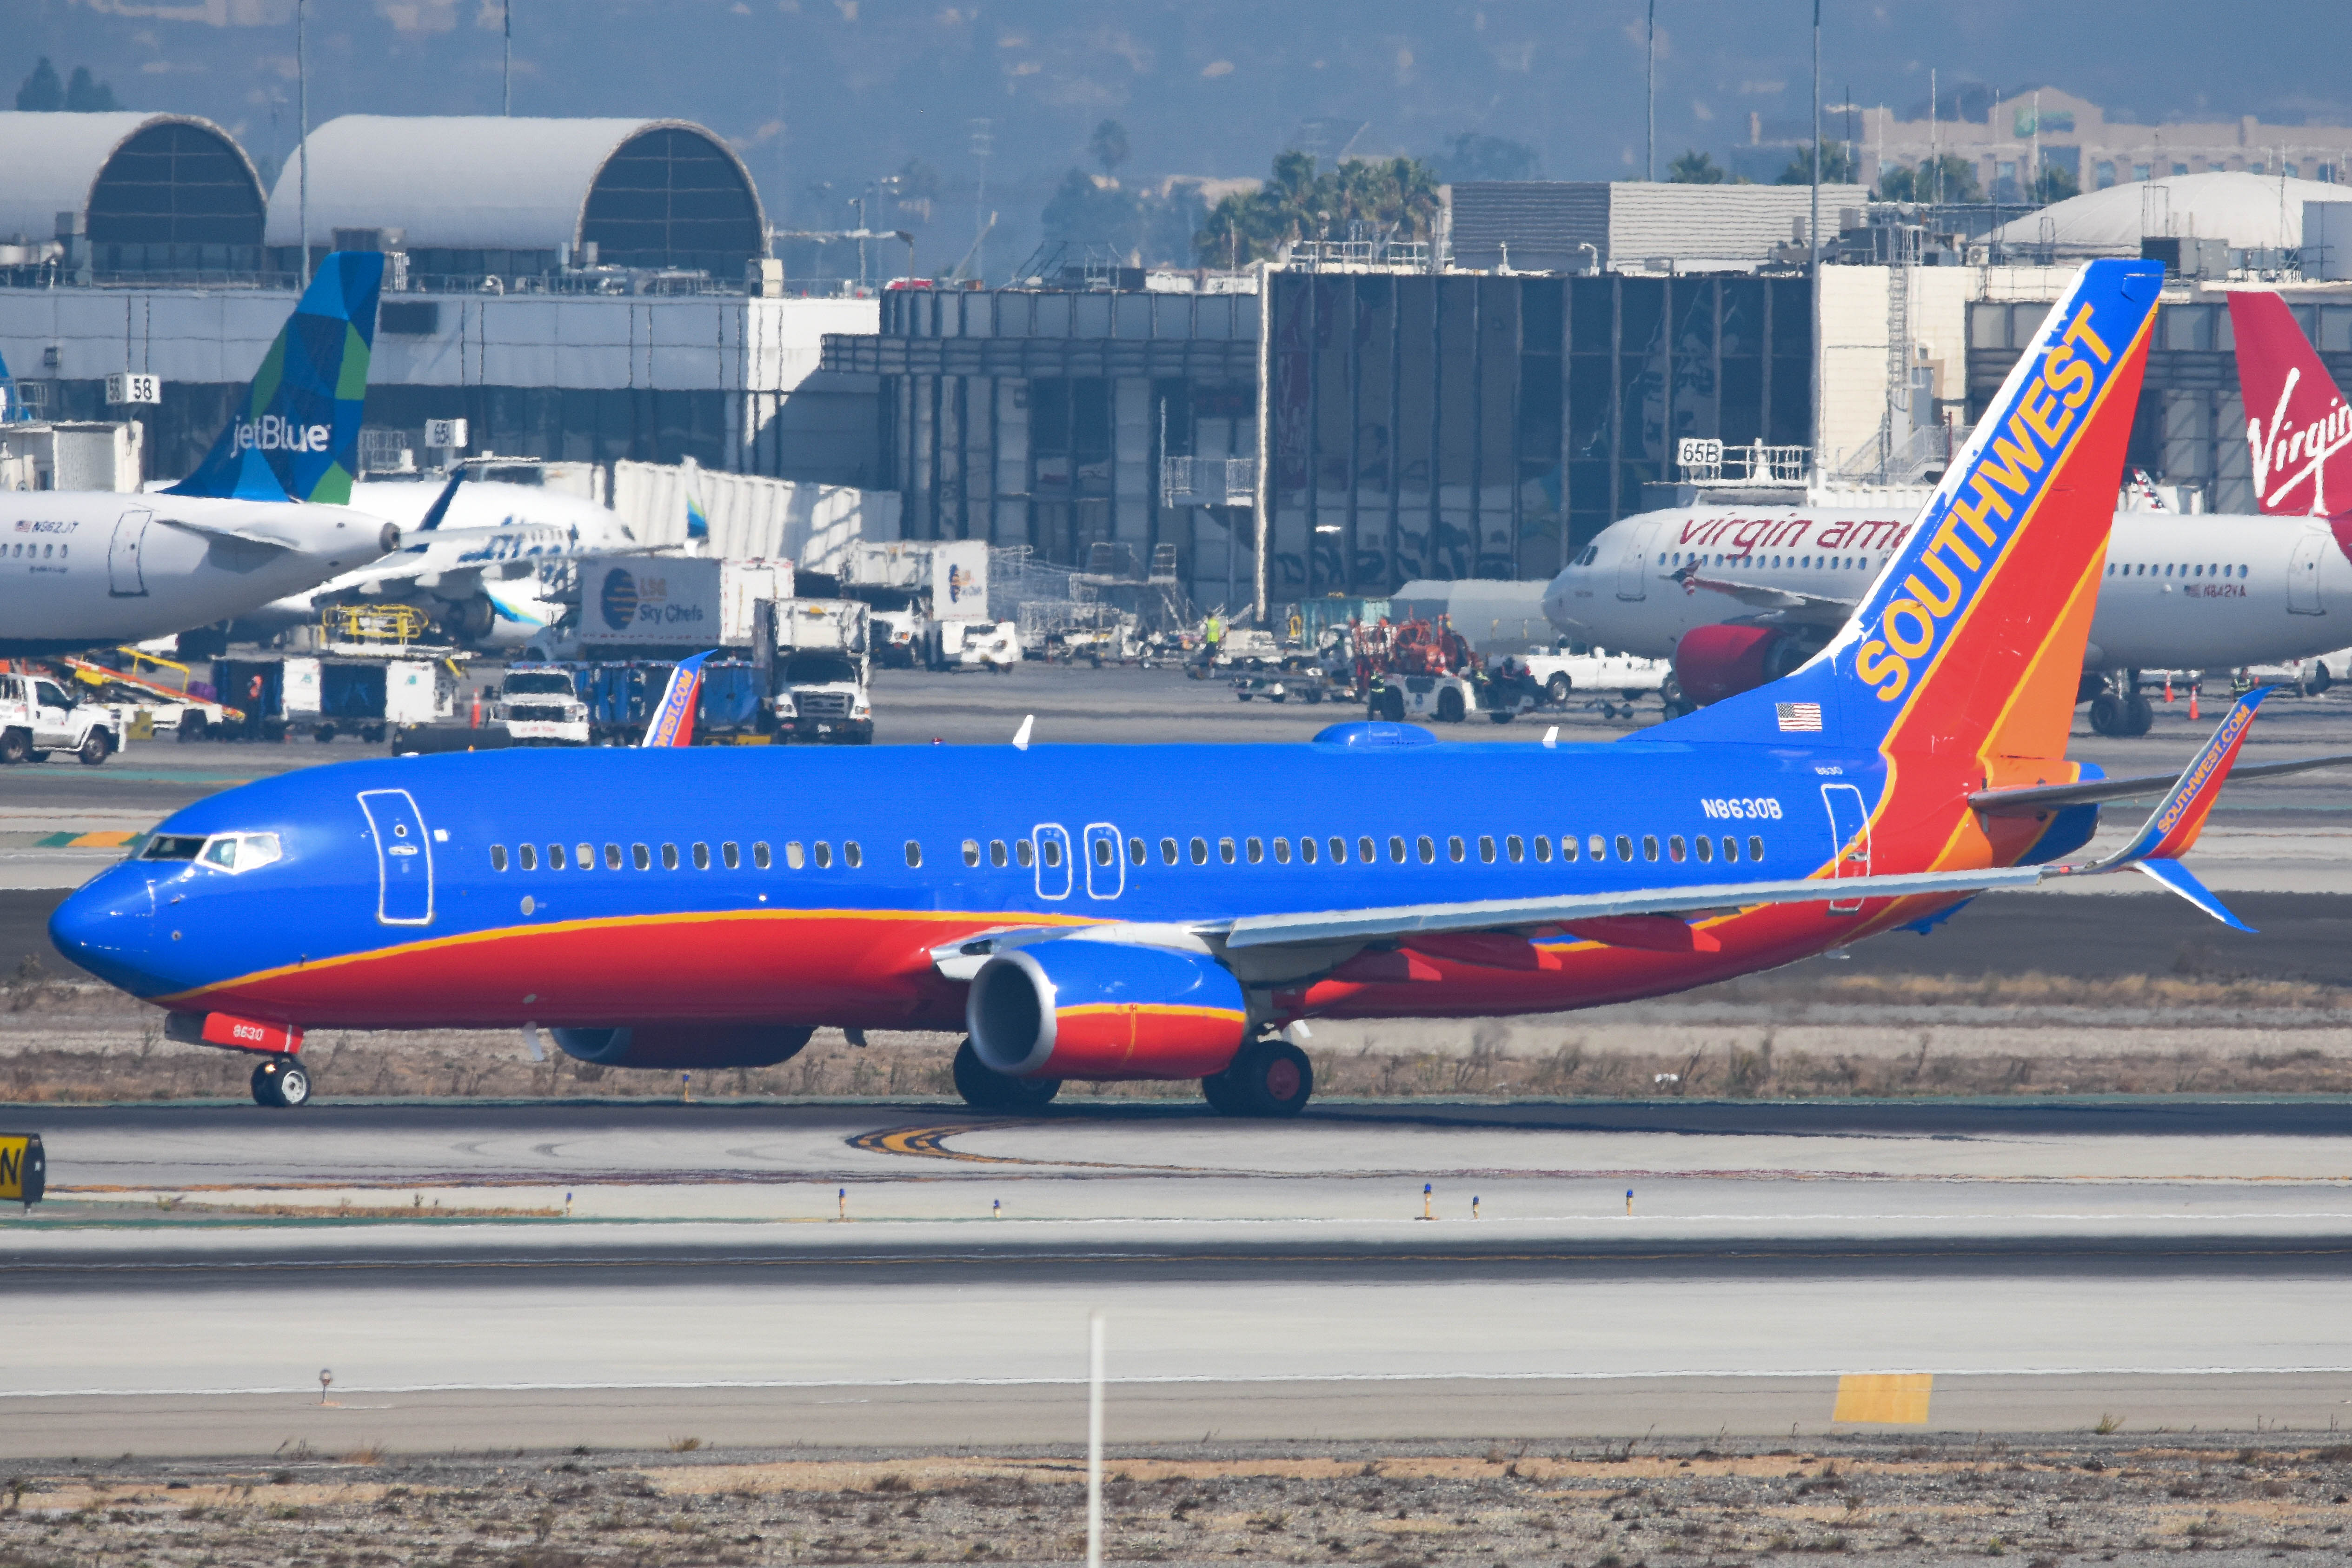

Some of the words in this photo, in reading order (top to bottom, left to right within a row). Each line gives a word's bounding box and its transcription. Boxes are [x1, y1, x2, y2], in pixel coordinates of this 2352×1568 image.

[133, 378, 152, 400] 58
[230, 415, 329, 458] jetBlue
[2247, 367, 2352, 515] Virgin
[1684, 443, 1719, 462] 65B
[1856, 302, 2112, 702] SOUTHWEST
[1680, 512, 1813, 560] virgin
[665, 604, 704, 623] Chefs
[1815, 766, 1843, 775] 8630
[2158, 704, 2259, 828] SOUTHWEST.COM
[1701, 798, 1782, 819] N8630B
[233, 1024, 264, 1041] 8630
[0, 1147, 21, 1184] N
